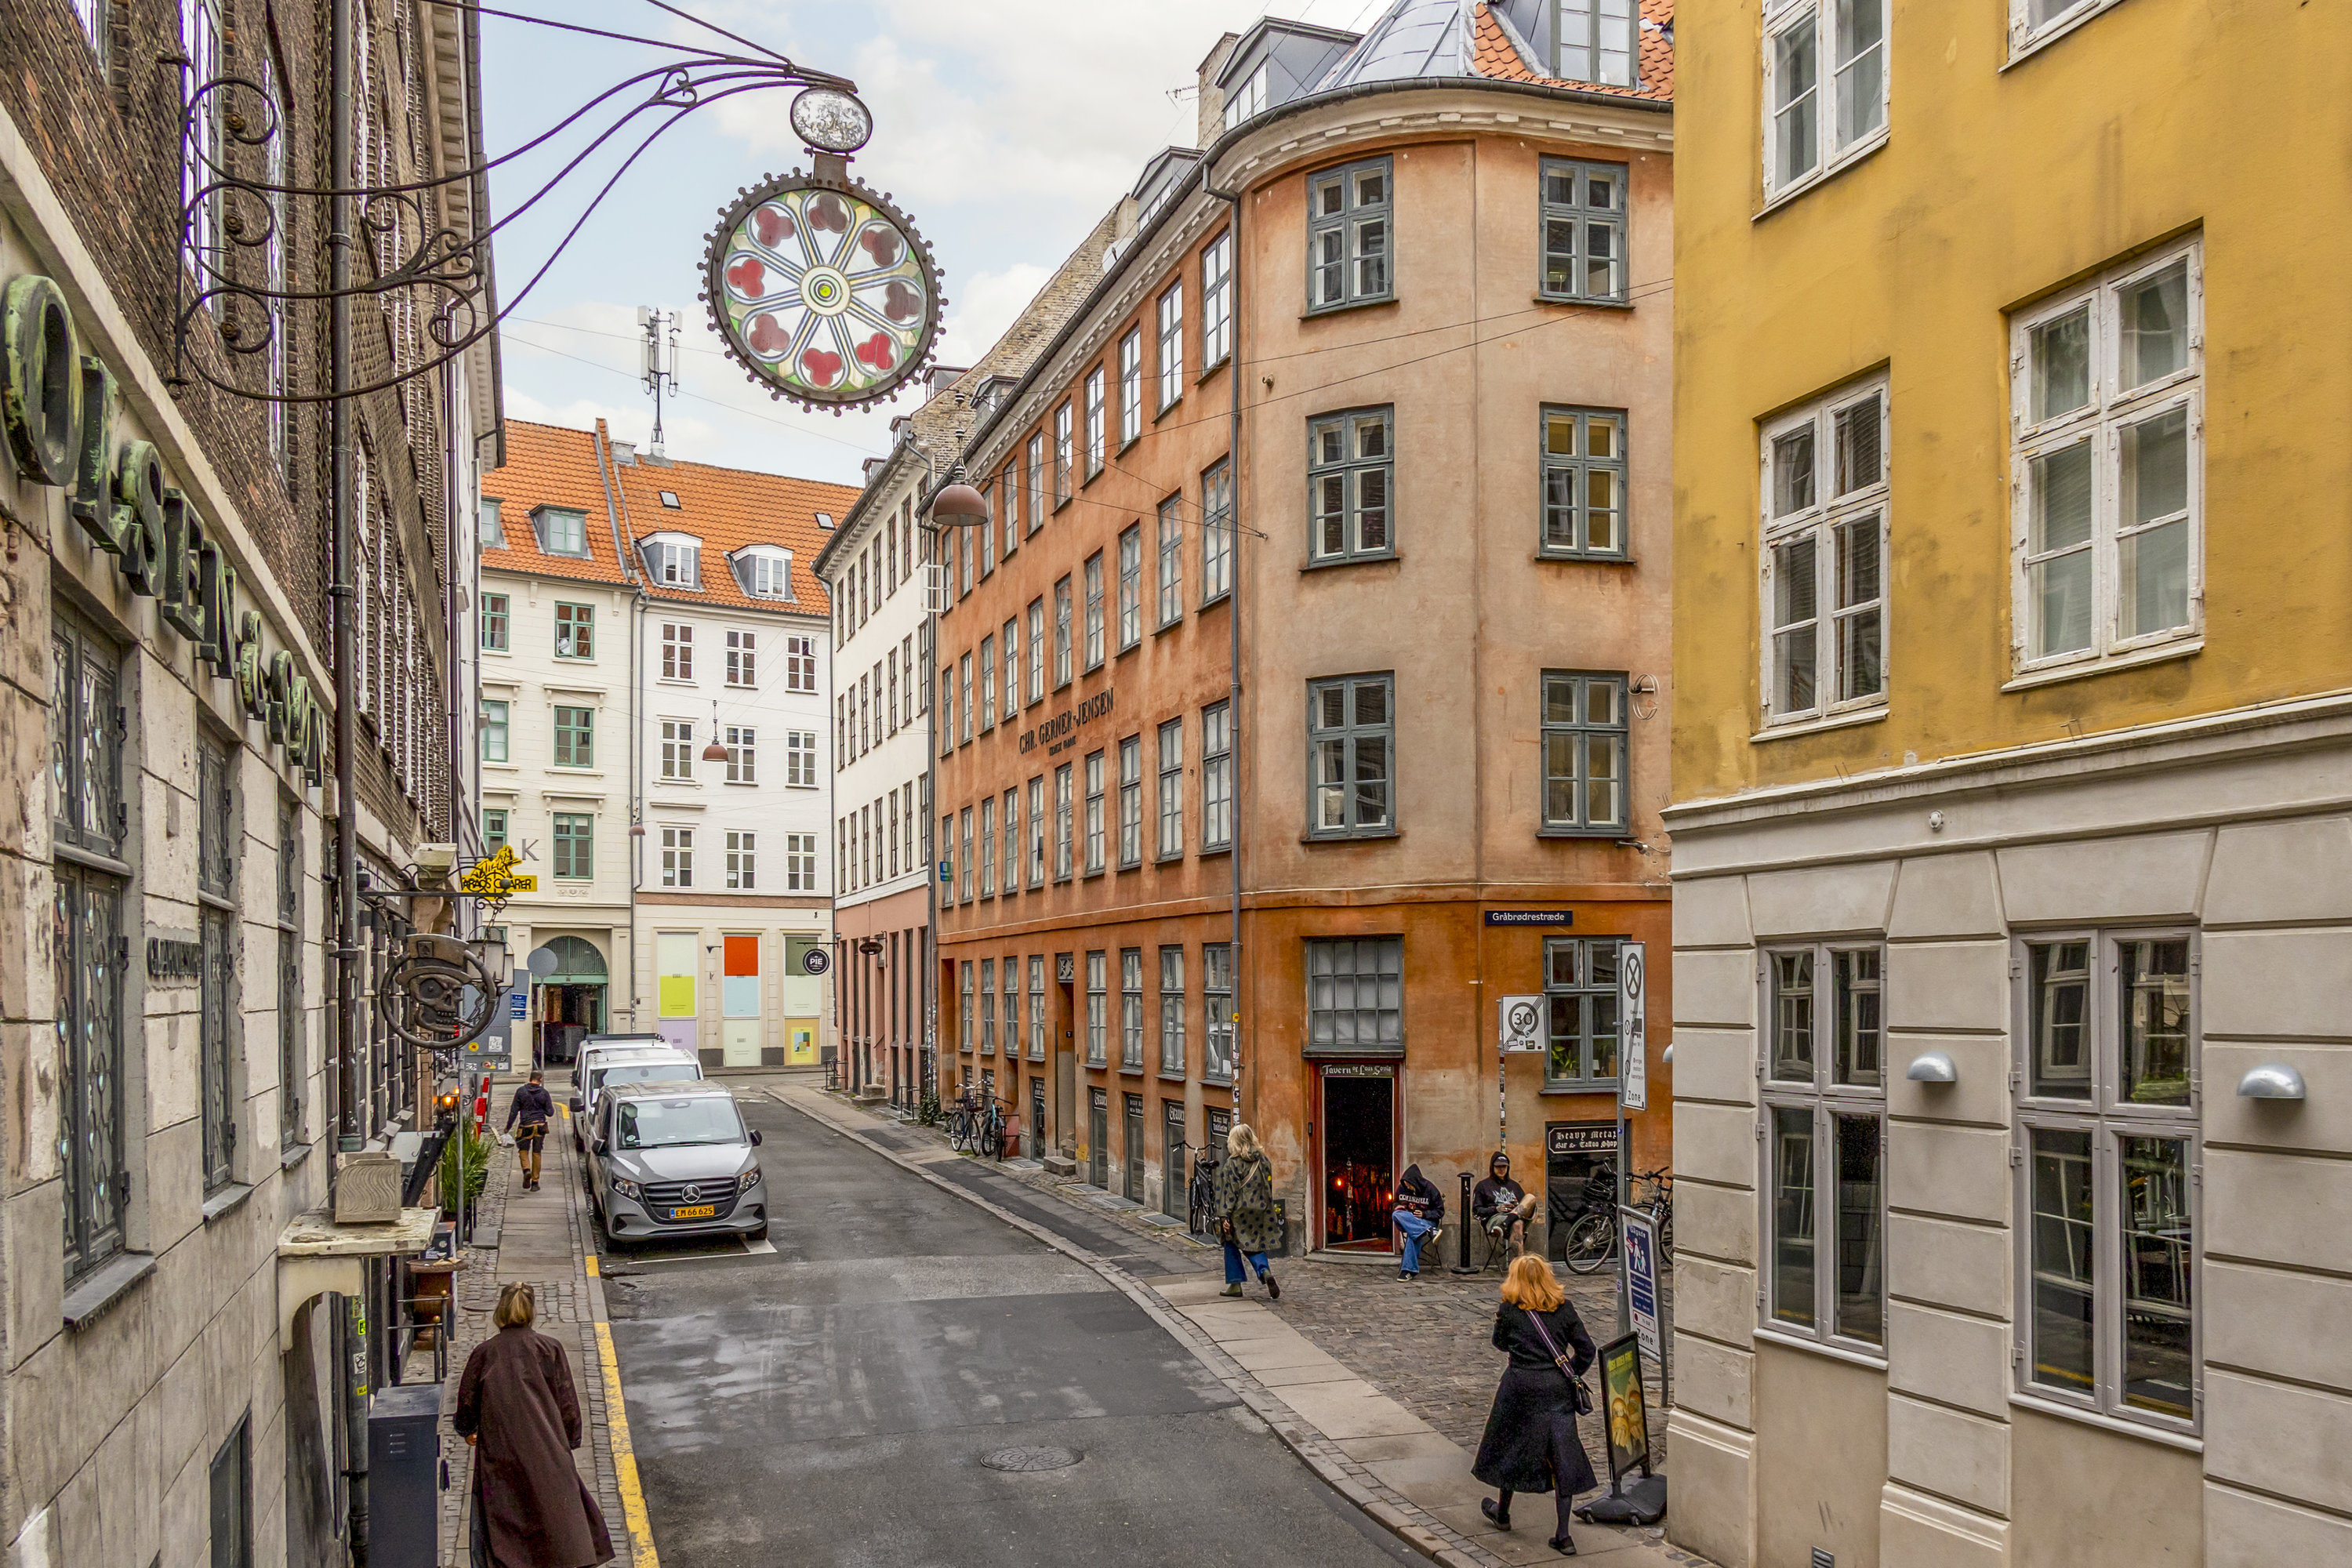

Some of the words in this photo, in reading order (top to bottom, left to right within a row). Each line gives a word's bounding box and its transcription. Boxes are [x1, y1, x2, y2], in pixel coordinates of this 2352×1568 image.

[2, 275, 236, 680] OLSEN
[1019, 729, 1037, 754] CHR.
[521, 838, 539, 861] K
[494, 878, 532, 890] CARER
[1492, 913, 1565, 921] Gråbrødrestræde
[1514, 1013, 1533, 1025] 30
[1322, 1065, 1351, 1075] Tavern
[1628, 1091, 1641, 1102] Zone
[1556, 1131, 1585, 1141] Heavy
[1636, 1327, 1653, 1345] Zone
